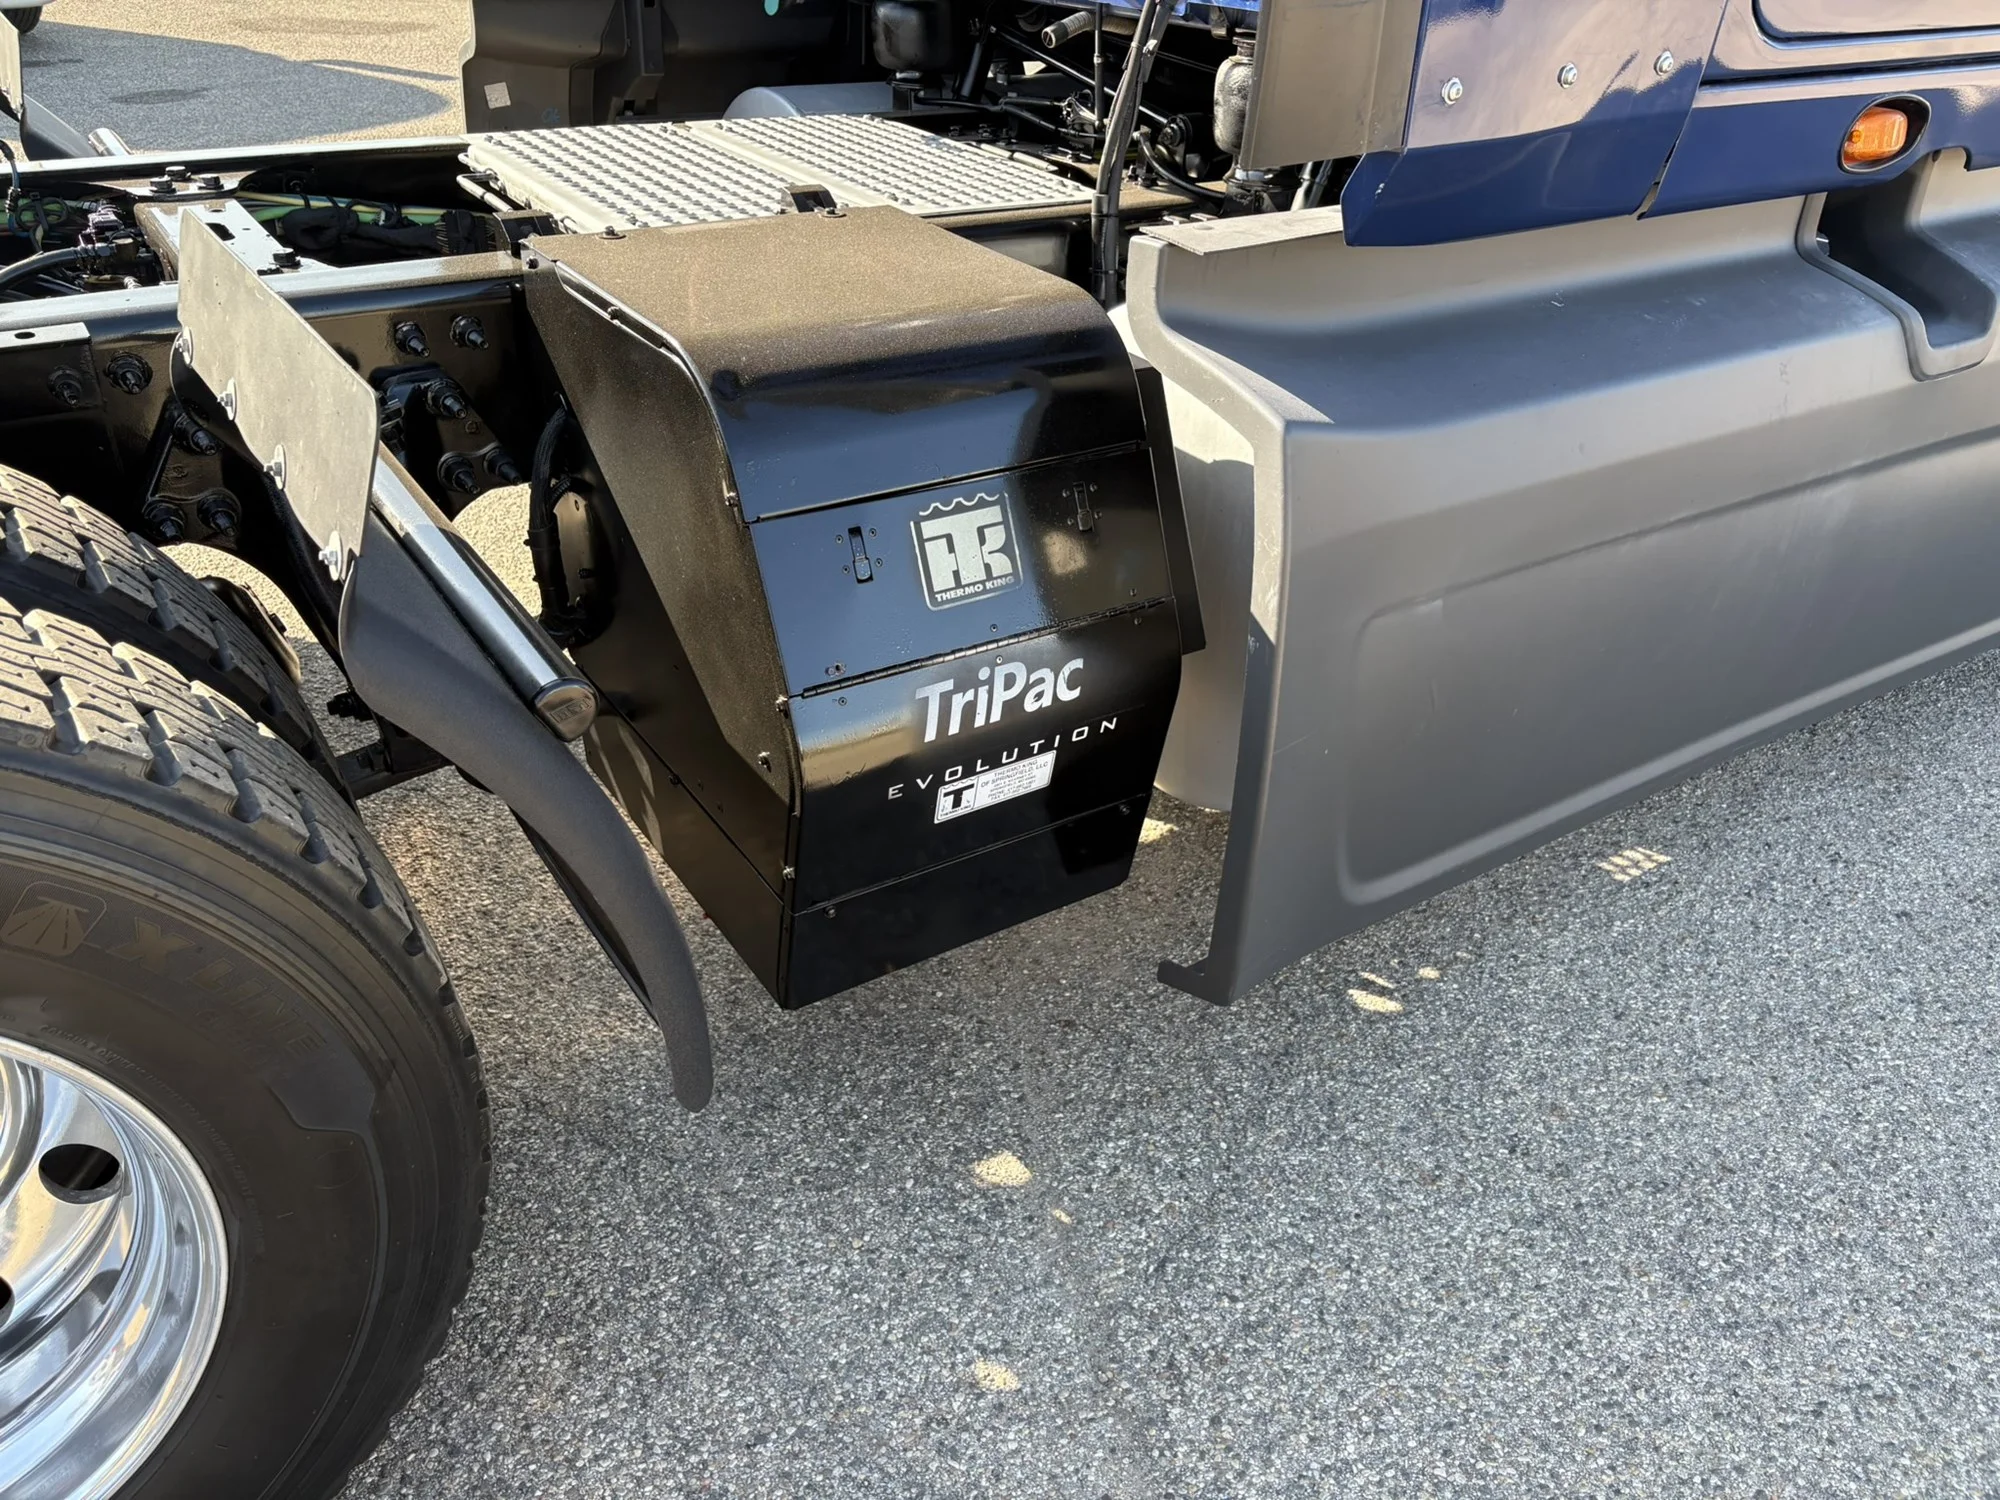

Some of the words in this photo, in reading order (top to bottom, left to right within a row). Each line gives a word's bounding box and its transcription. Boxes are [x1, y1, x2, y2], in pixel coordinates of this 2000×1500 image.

[935, 584, 983, 602] THERMO
[985, 576, 1015, 590] KING
[915, 657, 1084, 743] TriPac
[888, 717, 1117, 800] EVOLUTION
